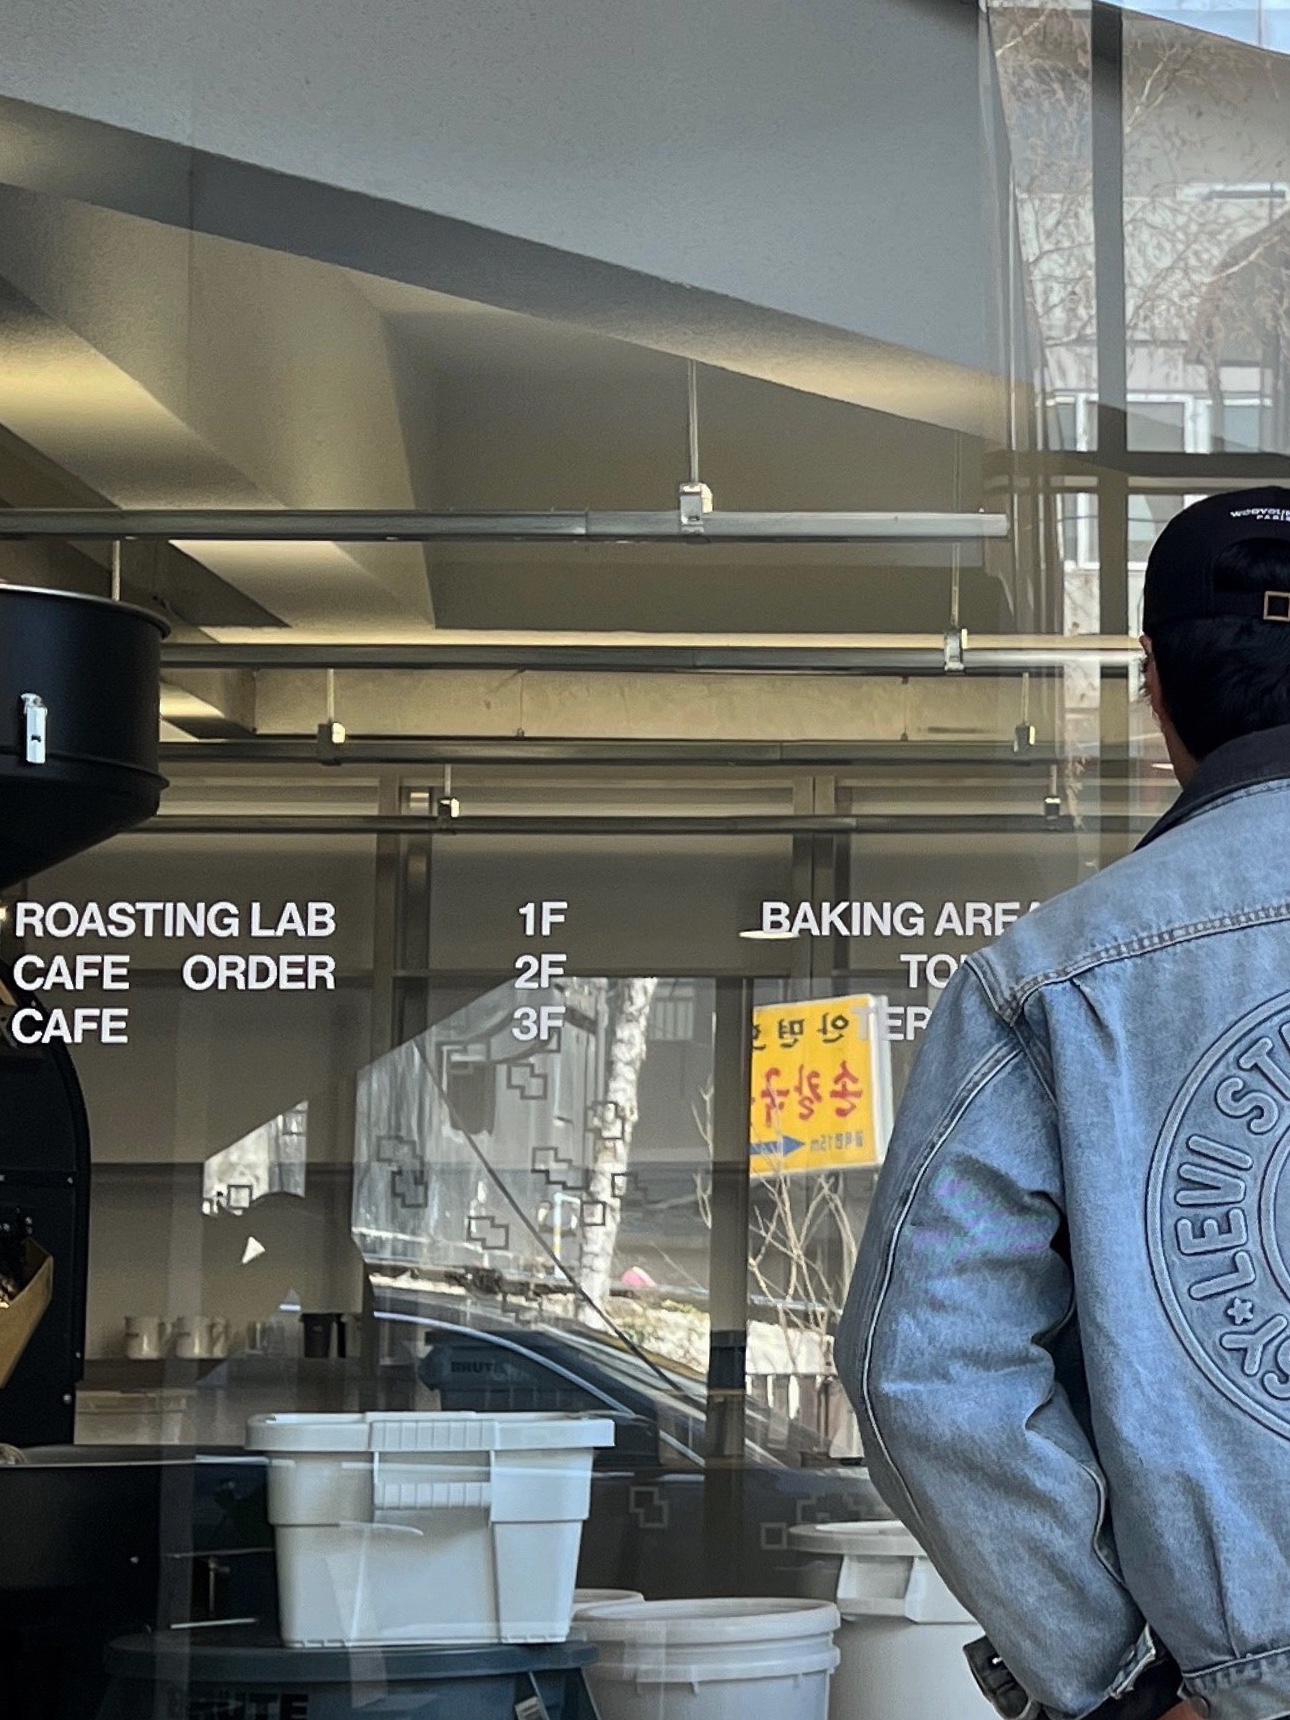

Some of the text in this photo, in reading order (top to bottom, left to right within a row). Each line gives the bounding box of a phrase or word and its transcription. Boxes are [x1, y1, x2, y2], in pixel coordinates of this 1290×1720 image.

[15, 901, 336, 937] ROASTING LAB
[518, 901, 568, 936] 1F
[761, 901, 1041, 936] BAKING ARE
[13, 954, 336, 990] CAFE ORDER
[514, 954, 567, 989] 2F
[899, 954, 968, 989] TO
[11, 1008, 129, 1044] CAFE
[512, 1006, 566, 1041] 3F
[1175, 1134, 1256, 1301] LEVI
